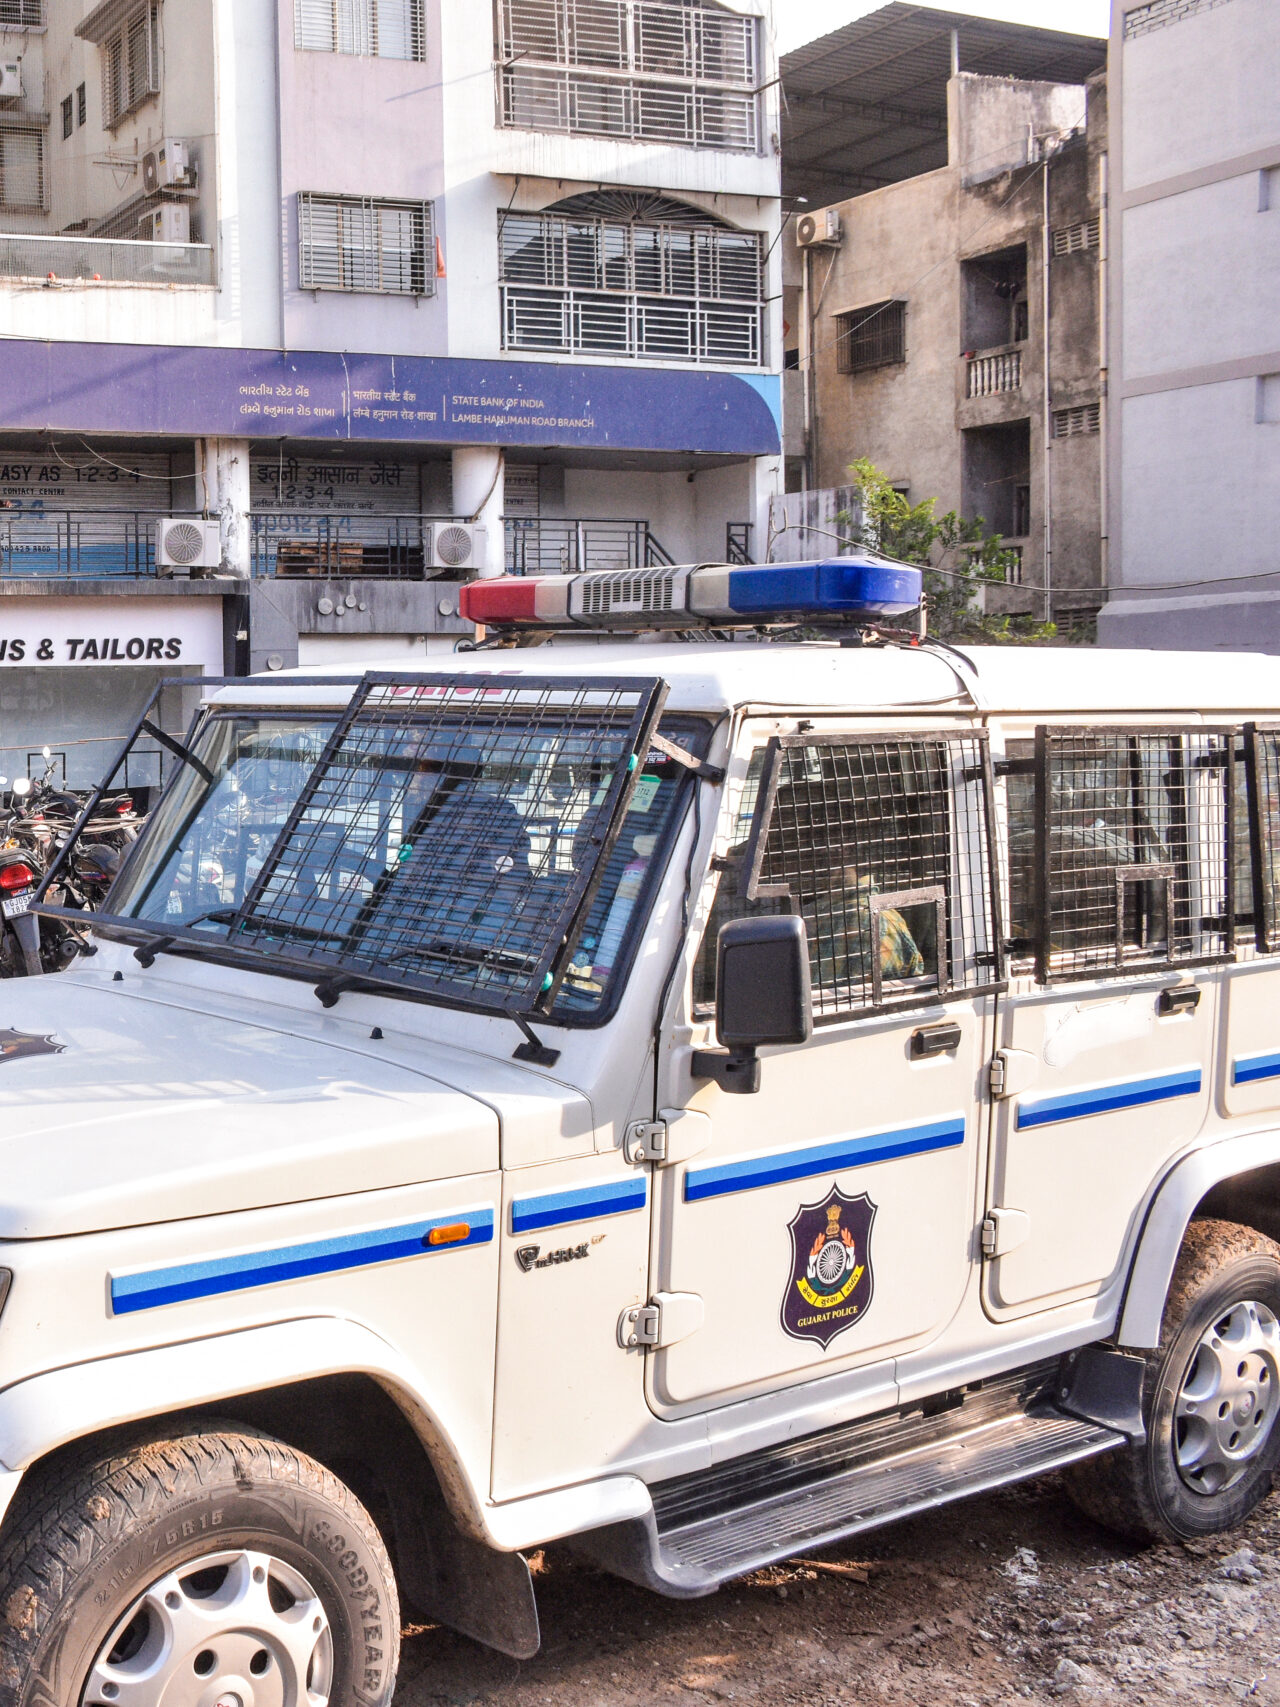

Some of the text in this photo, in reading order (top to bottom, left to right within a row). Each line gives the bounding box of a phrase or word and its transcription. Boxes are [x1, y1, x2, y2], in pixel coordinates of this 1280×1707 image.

[239, 383, 273, 395] ભારતીય
[275, 384, 293, 397] સ્ટેટ
[352, 388, 382, 400] भारतीय
[452, 395, 545, 408] STATE BANK OF INDIA
[263, 405, 294, 418] હનુમાન
[297, 403, 311, 416] રોડ
[313, 407, 335, 417] શાખા
[451, 412, 595, 428] LAMBE HANUMAN ROAD BRANCH
[38, 465, 61, 482] AS
[257, 457, 301, 484] इतनी
[306, 465, 364, 485] आसान
[3, 487, 39, 495] CONTACT
[39, 488, 66, 496] CENTRE
[35, 639, 55, 661] &
[64, 637, 183, 661] TAILORS
[797, 1305, 859, 1328] GUJARAT POLICE
[311, 1519, 383, 1692] GOODYEAR
